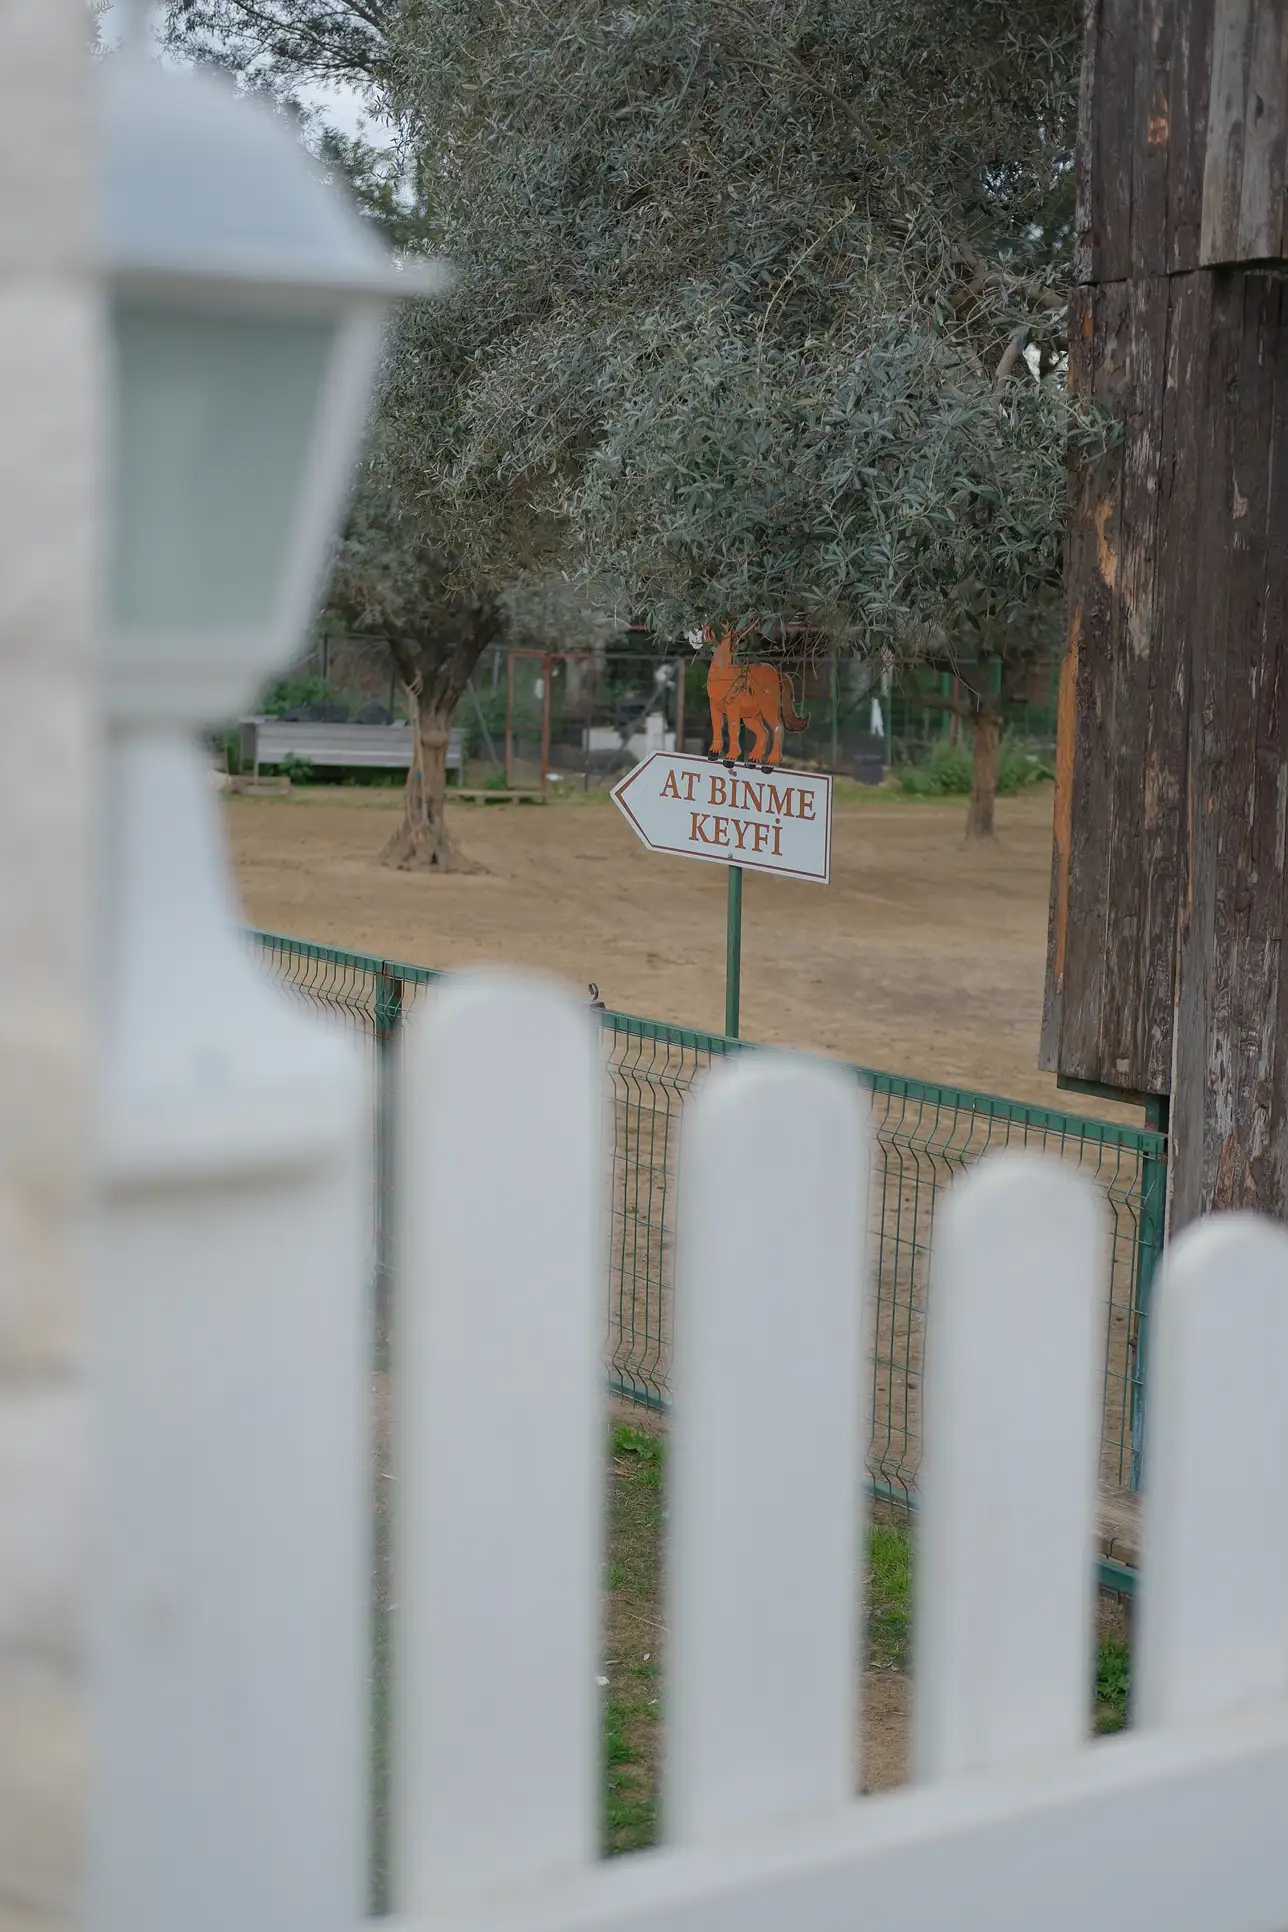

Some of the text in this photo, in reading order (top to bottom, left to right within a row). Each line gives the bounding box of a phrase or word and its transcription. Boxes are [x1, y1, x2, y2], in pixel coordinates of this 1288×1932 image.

[659, 769, 816, 821] AT BİNME
[688, 811, 783, 856] KEYFİ
